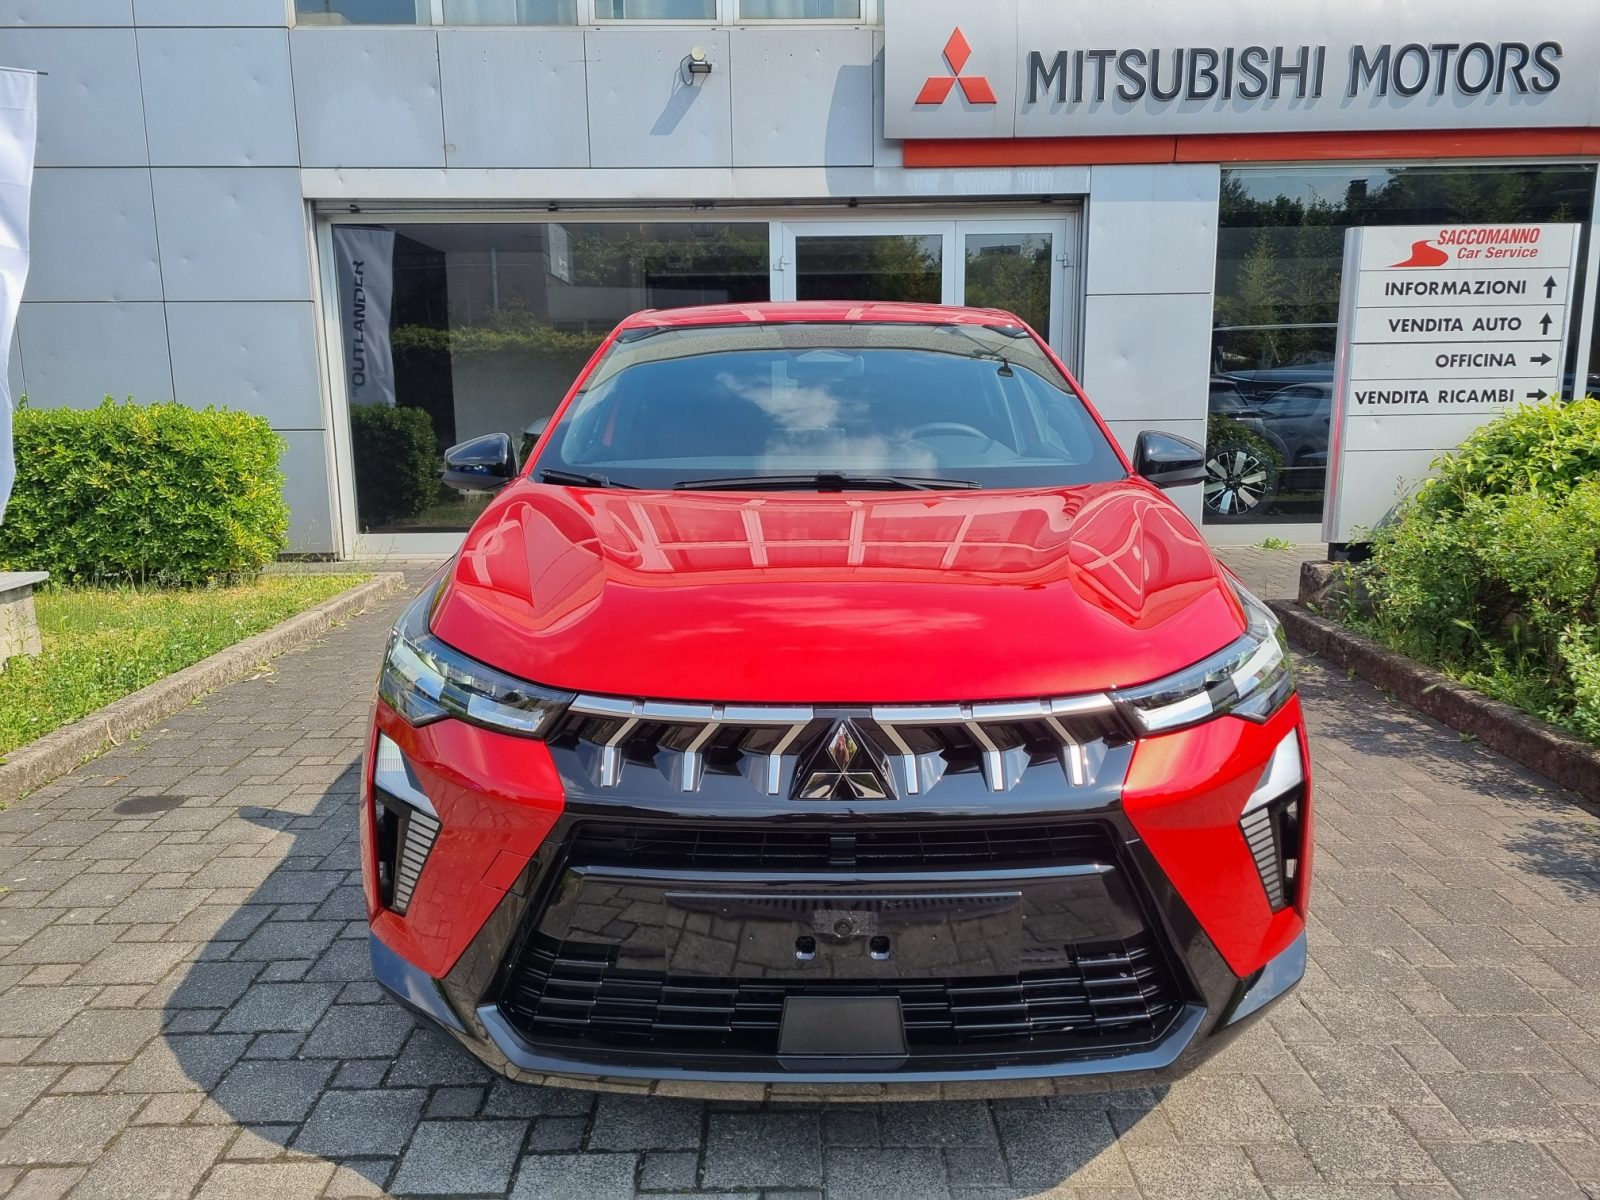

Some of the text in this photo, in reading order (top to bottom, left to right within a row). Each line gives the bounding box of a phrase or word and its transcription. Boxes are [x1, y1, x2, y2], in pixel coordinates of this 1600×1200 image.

[1028, 40, 1563, 104] MITSUBISHI MOTORS
[1437, 228, 1540, 245] SACCOMANNO
[1457, 246, 1538, 259] Car Service
[1385, 280, 1526, 296] INFORMAZIONI
[1388, 317, 1522, 332] VENDITA AUTO
[1435, 353, 1517, 368] OFFICINA
[1355, 389, 1515, 404] VENDITA RICAMBI
